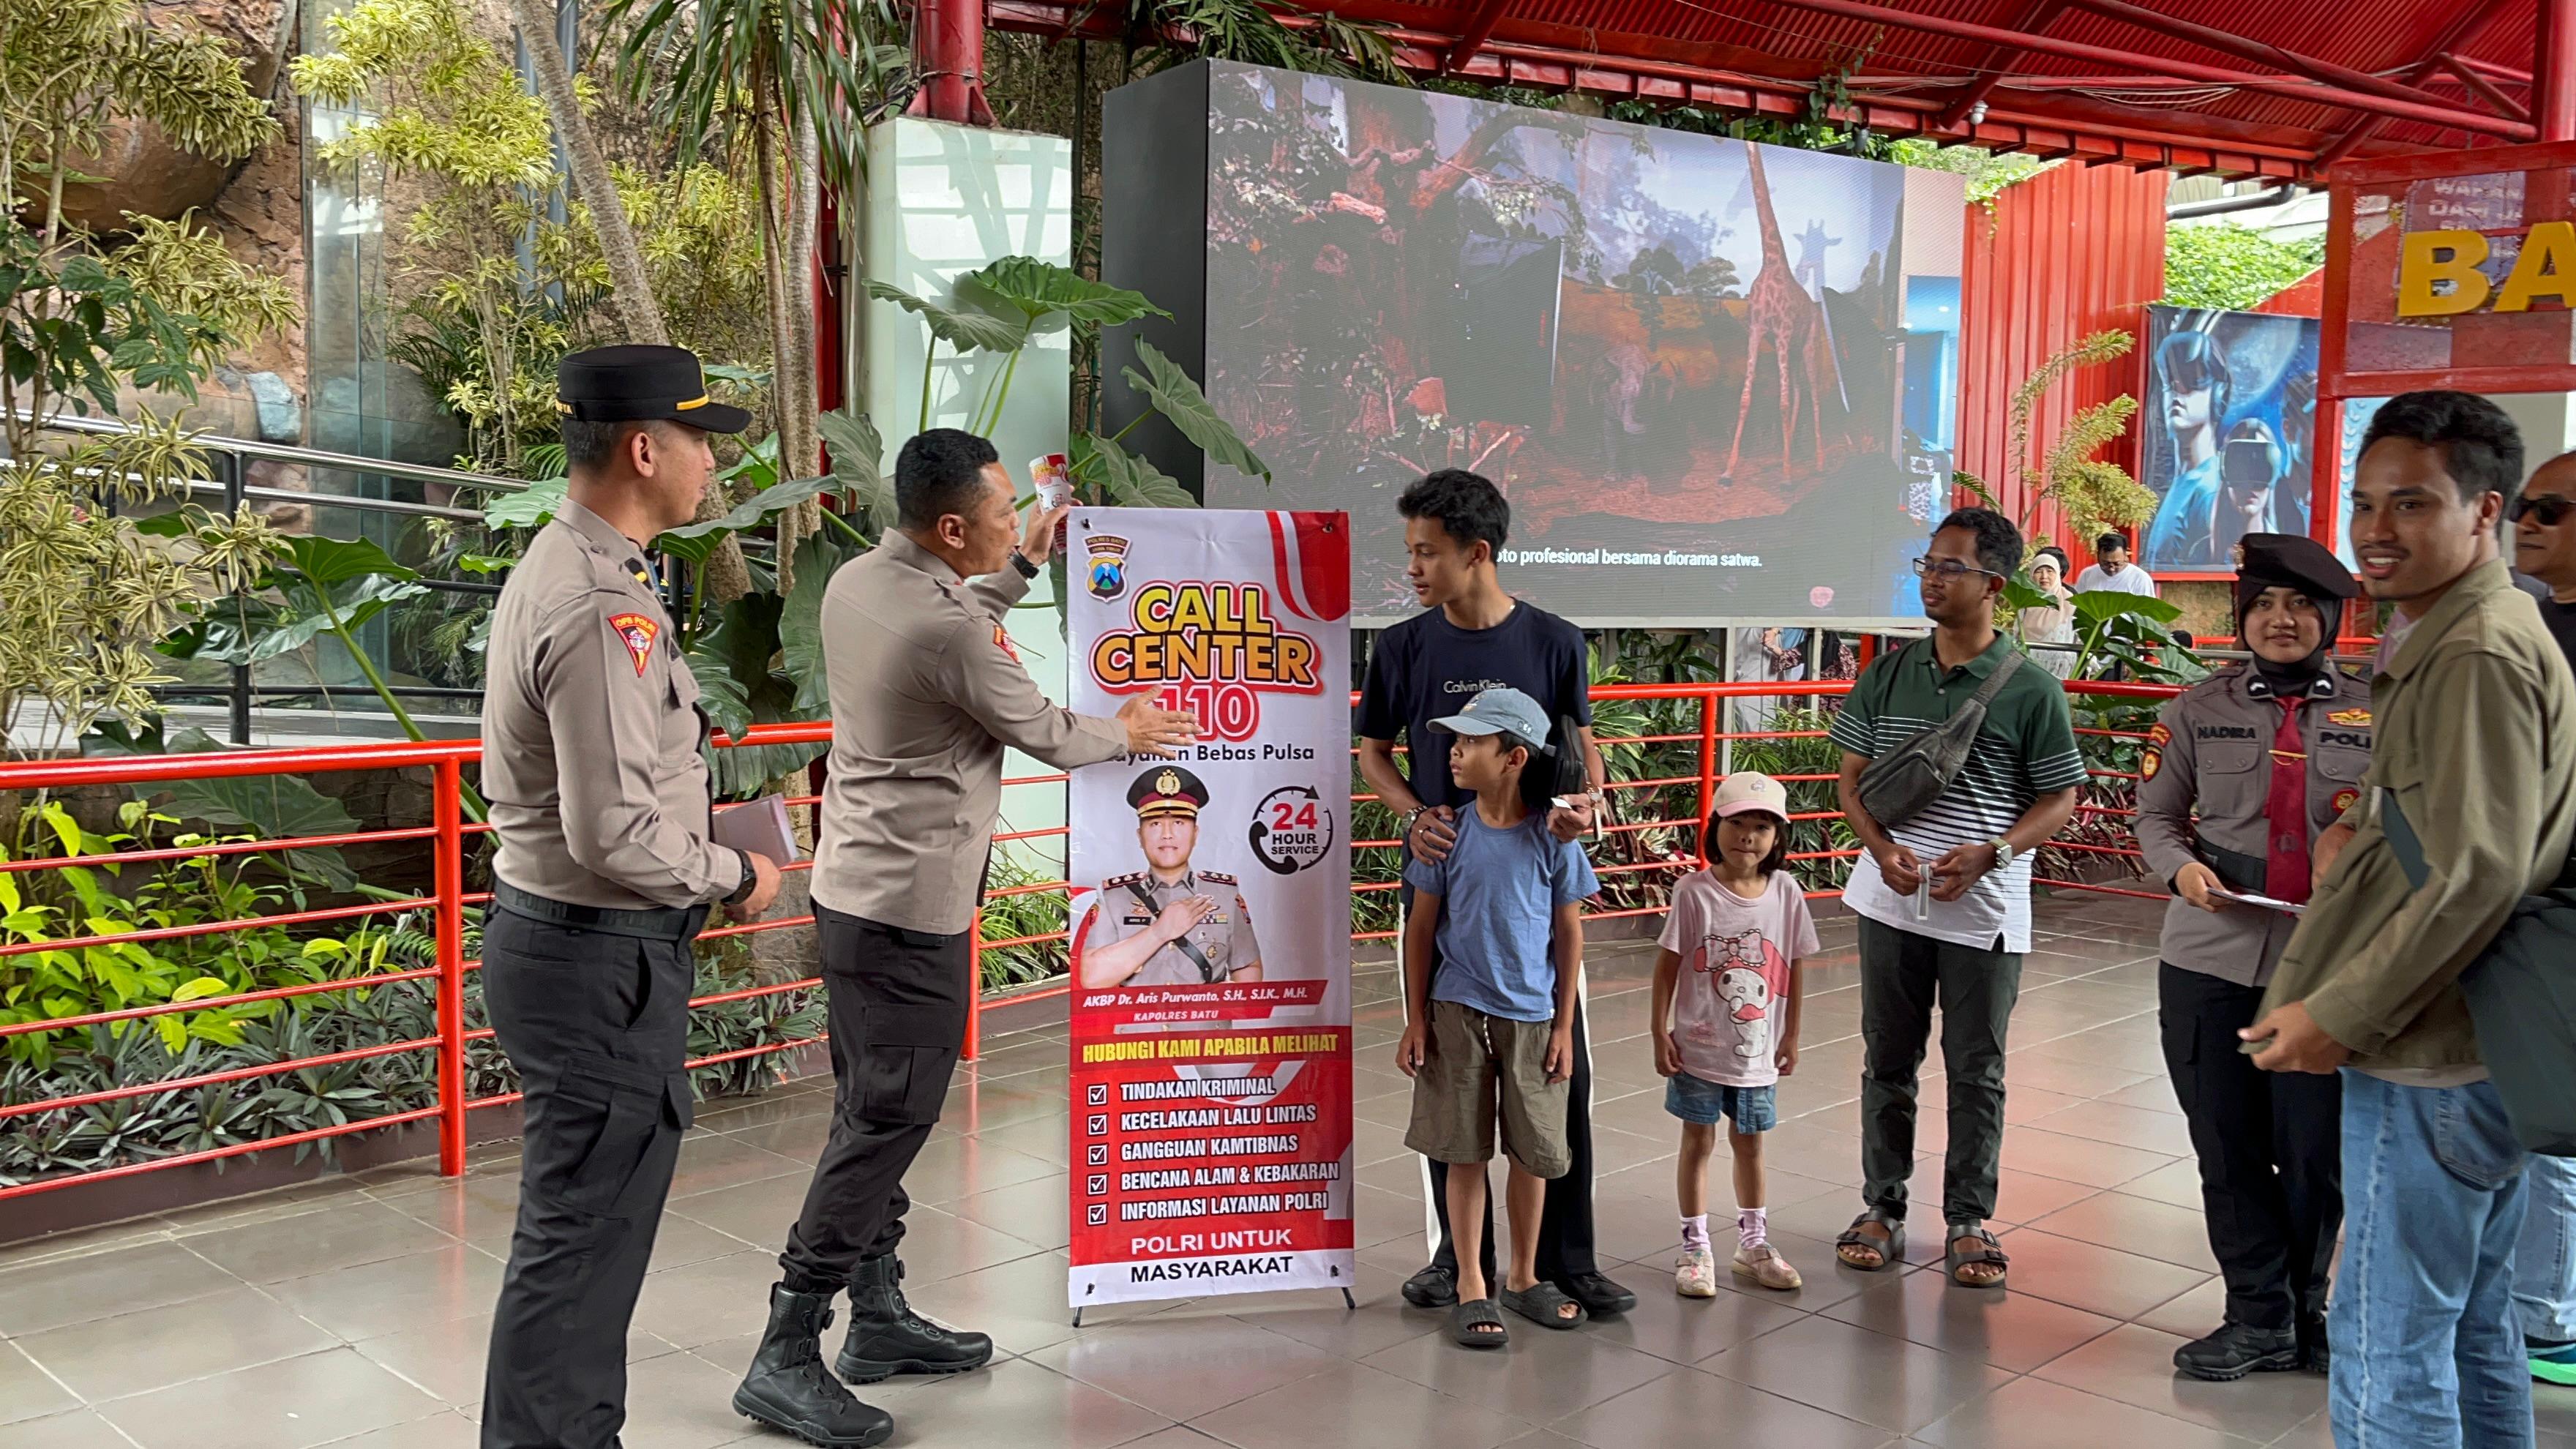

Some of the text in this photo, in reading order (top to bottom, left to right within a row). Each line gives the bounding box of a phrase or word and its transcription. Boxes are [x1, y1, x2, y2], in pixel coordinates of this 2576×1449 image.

[2397, 221, 2576, 316] BA
[1520, 549, 1599, 566] profesional
[1602, 550, 1661, 565] bersama
[1664, 550, 1718, 566] diorama
[1721, 554, 1762, 567] satwa.
[1135, 585, 1273, 634] CALL
[1093, 633, 1314, 685] CENTER
[1197, 744, 1256, 760] Bebas
[1263, 744, 1314, 760] Pulsa
[1272, 803, 1318, 831] 24
[1271, 845, 1319, 855] SERVICE
[1272, 834, 1317, 845] HOUR
[1083, 994, 1115, 1008] AKBP
[1117, 994, 1133, 1006] Dr.
[1136, 992, 1158, 1005] Aris
[1161, 990, 1220, 1003] Purwanto,
[1283, 986, 1308, 999] M.H.
[1134, 1008, 1219, 1022] KAPOLRES BATU
[1083, 1034, 1338, 1063] HUBUNGI KAMI APABILA MELIHAT
[1120, 1077, 1276, 1101] TINDAKAN KRIMINAL
[1121, 1104, 1317, 1131] KECELAKAAN LALU LINTAS
[1121, 1135, 1298, 1161] GANGGUAN KAMTIBNAS
[1121, 1162, 1339, 1191] BENCANA ALAM & KEBAKARAN
[1121, 1191, 1328, 1221] INFORMASI LAYANAN POLRI
[1131, 1228, 1292, 1256] POLRI UNTUK
[1131, 1256, 1293, 1284] MASYARAKAT
